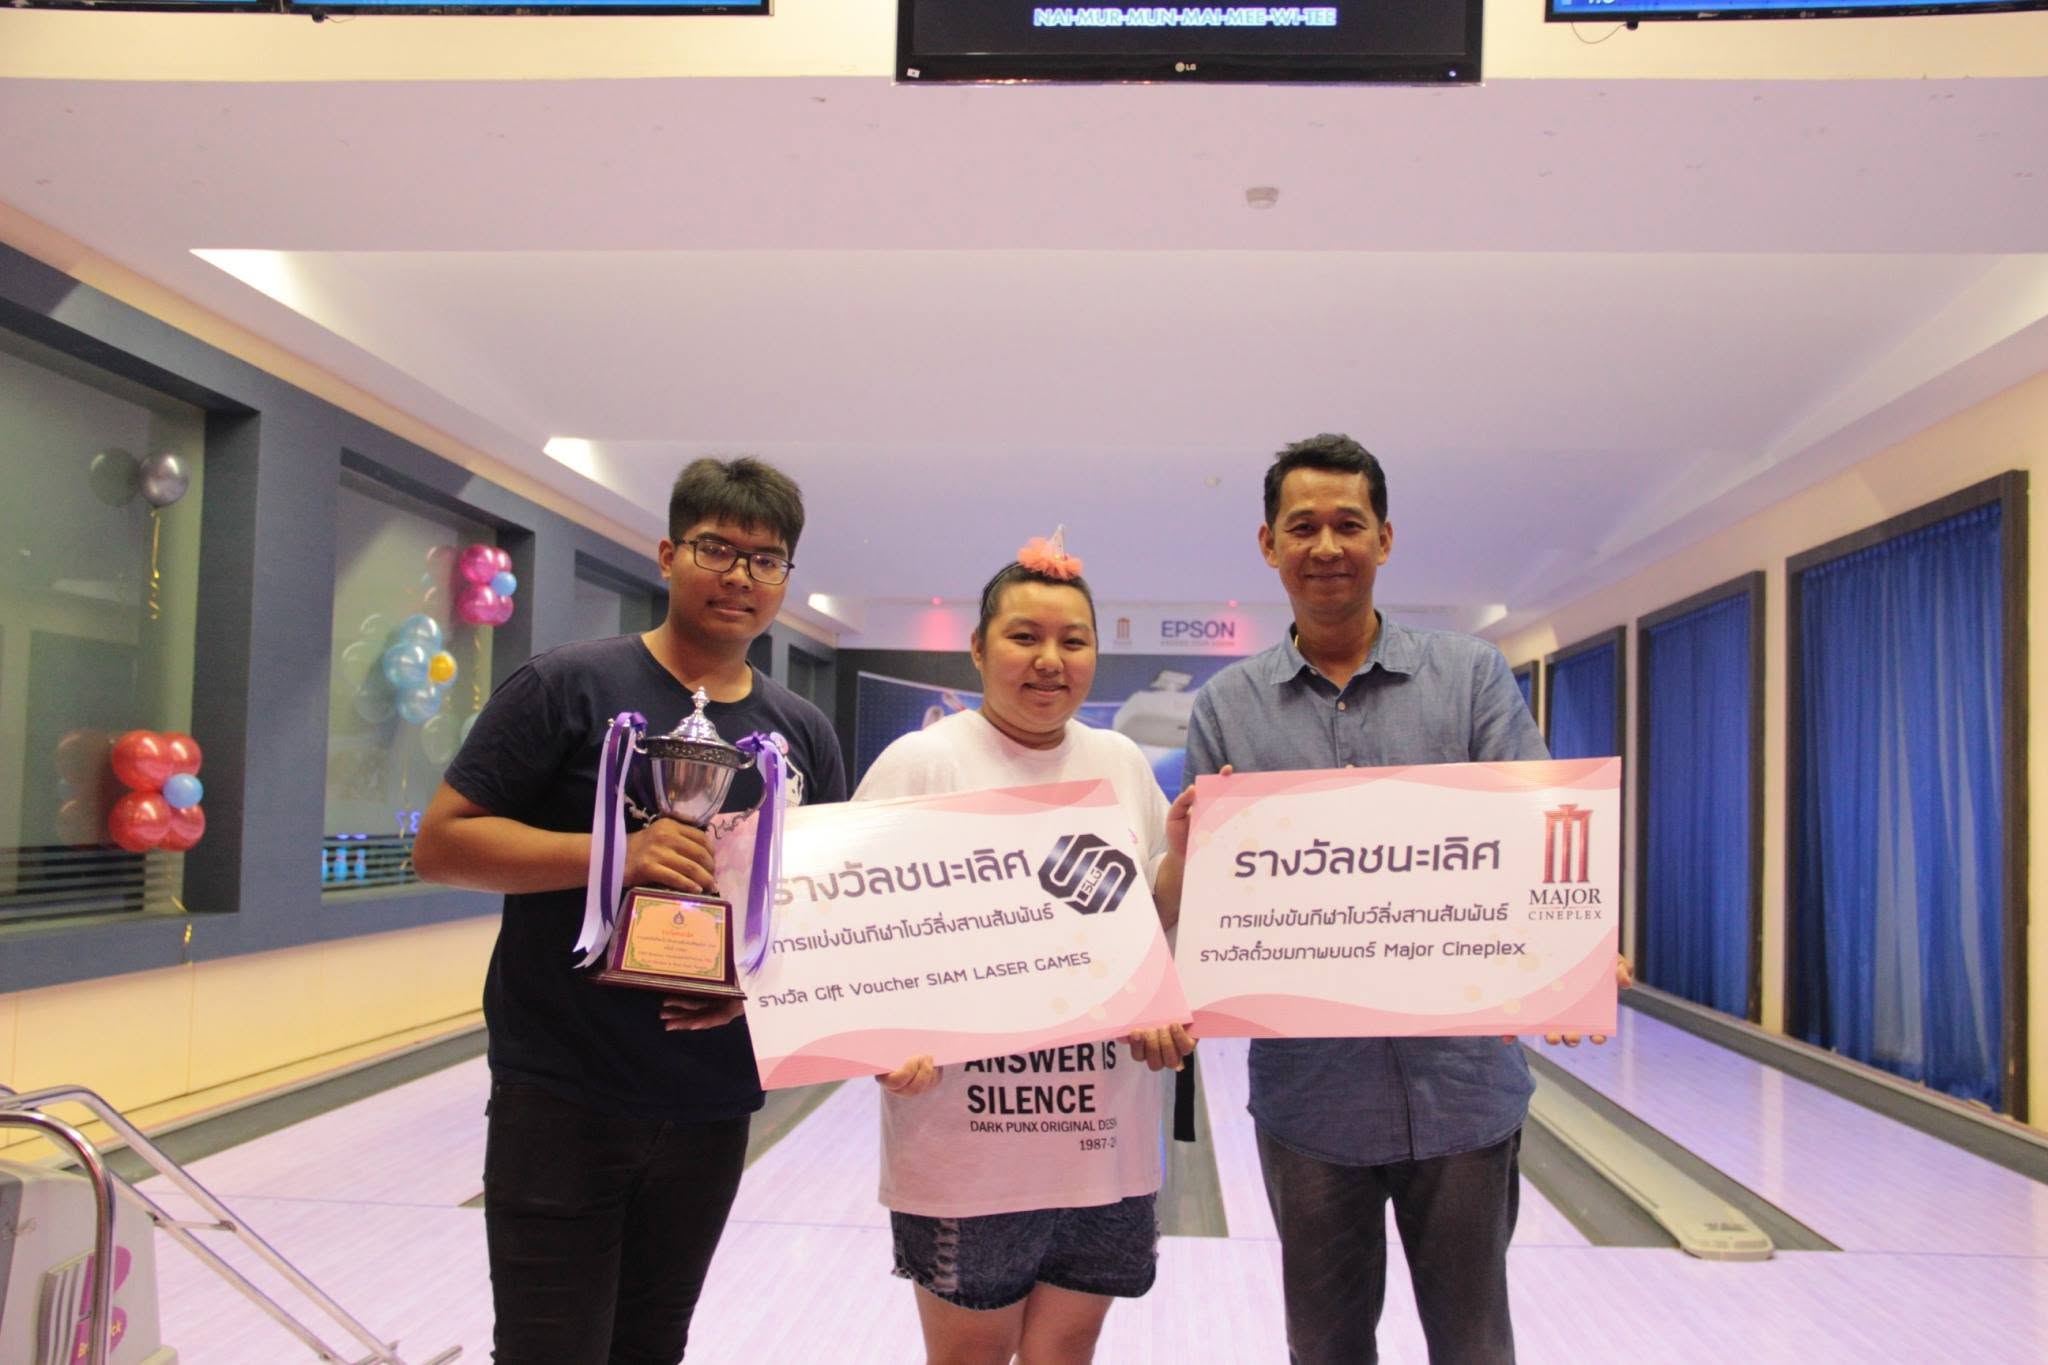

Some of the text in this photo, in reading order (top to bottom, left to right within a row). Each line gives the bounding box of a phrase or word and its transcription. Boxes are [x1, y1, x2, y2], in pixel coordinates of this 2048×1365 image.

[1161, 620, 1235, 638] EPSON
[1234, 836, 1501, 878] รางวัลชนะเลิศ
[773, 848, 1032, 905] รางวัลชนะเลิศ
[1529, 888, 1602, 909] MAJOR
[1219, 902, 1510, 928] การแข่งขันกีฬาโบว์ลิ่งสานสัมพันธ์
[1528, 910, 1602, 921] CINEPLEX
[1384, 942, 1434, 960] Major
[1442, 940, 1527, 959] Cineplex
[758, 952, 1092, 1008] รางวัล Gift Voucher SIAM LASER GAMES
[1101, 1040, 1117, 1071] IS
[967, 1084, 1096, 1115] SILENCE
[970, 1120, 1003, 1133] DARK
[1006, 1121, 1038, 1133] PUNX
[1040, 1119, 1095, 1133] ORIGINAL
